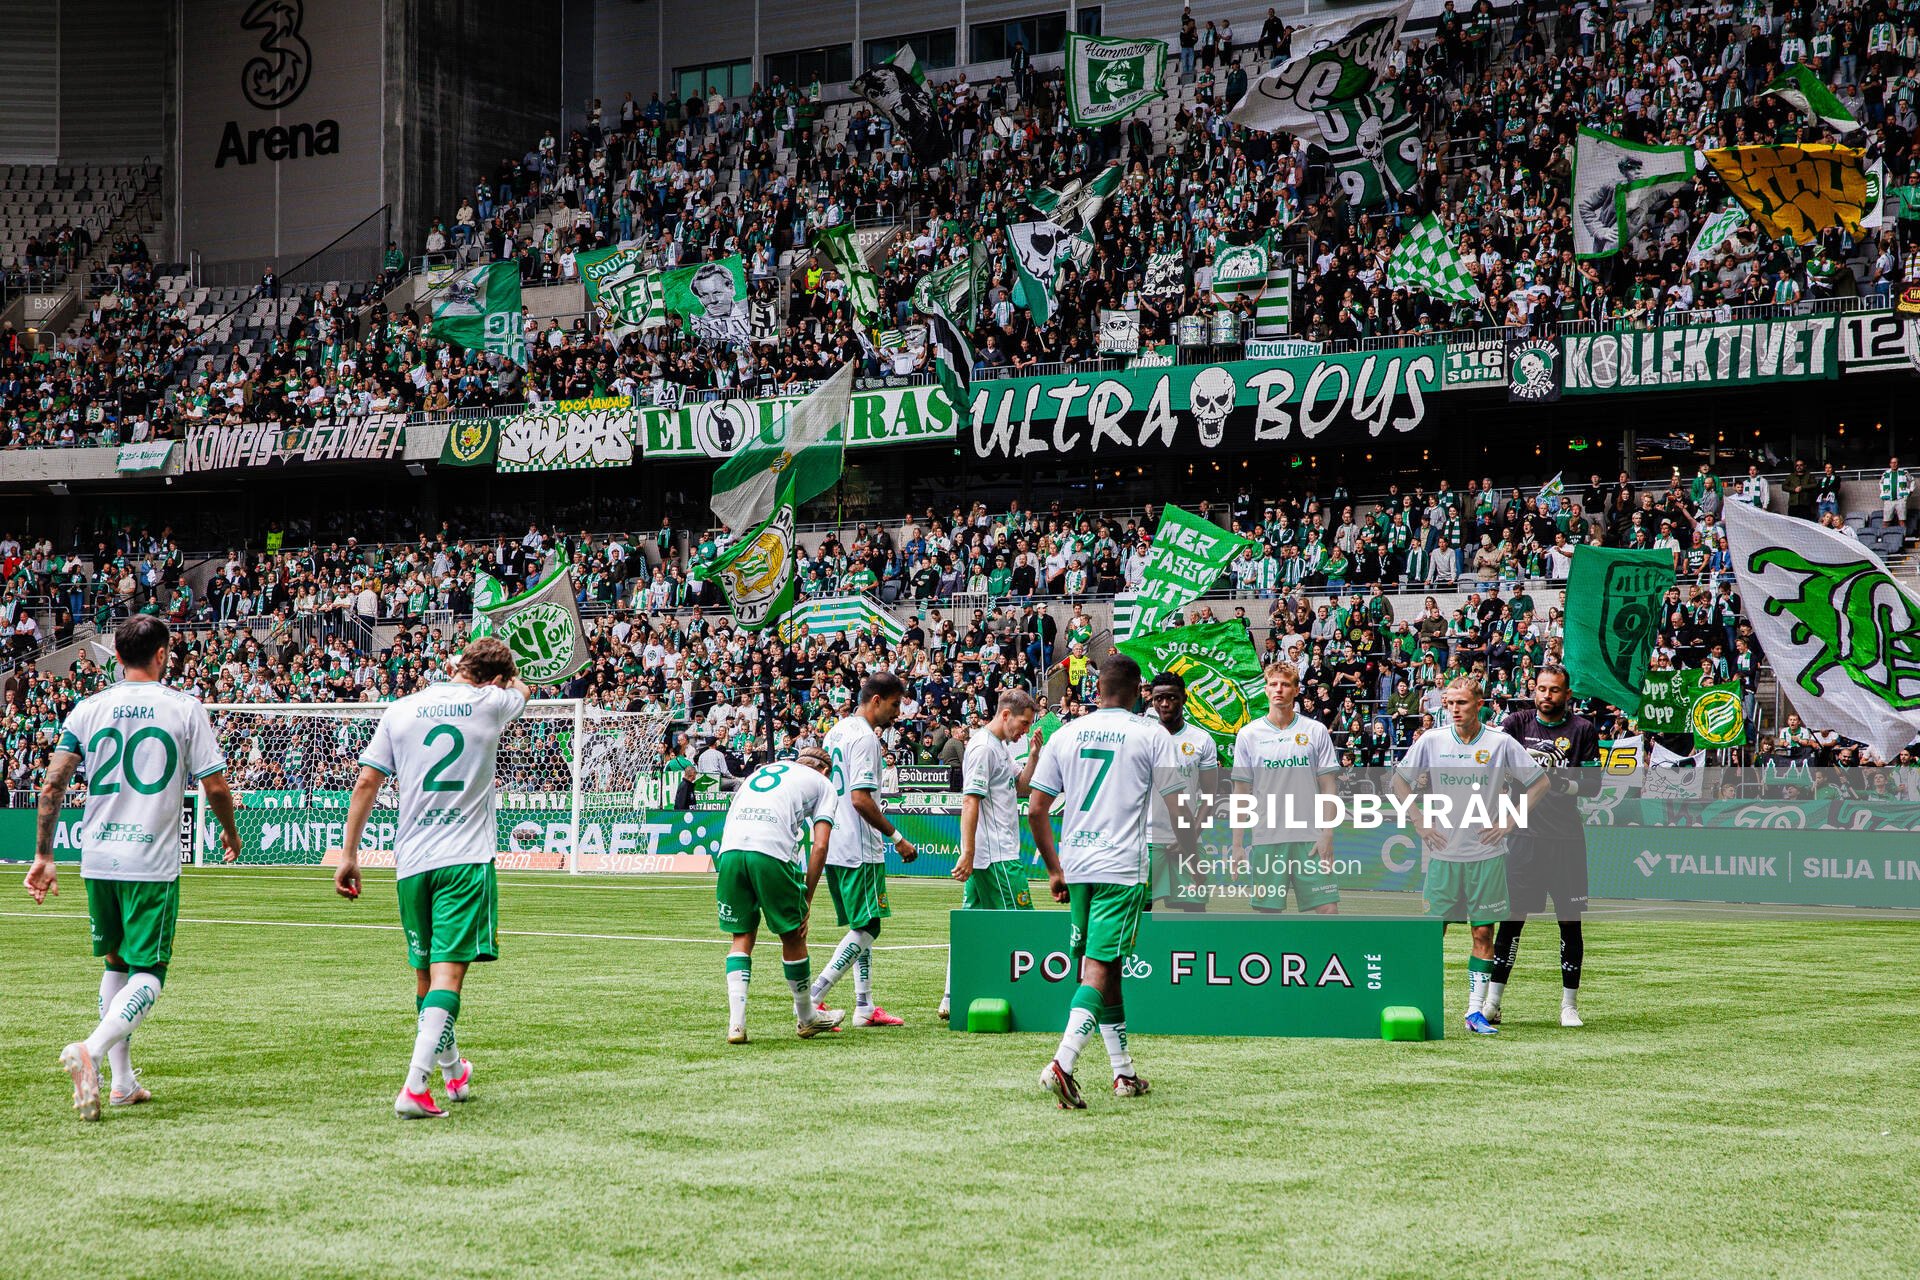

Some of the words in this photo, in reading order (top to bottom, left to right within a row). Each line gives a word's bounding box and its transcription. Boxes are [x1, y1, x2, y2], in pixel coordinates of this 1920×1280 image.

[214, 118, 340, 168] Arena
[1446, 342, 1476, 354] ULTRA
[1477, 340, 1504, 351] BOYS
[1847, 315, 1906, 359] 12
[1447, 350, 1504, 369] 116
[1565, 317, 1836, 389] KOLLEKTIVET
[1447, 366, 1502, 382] SOFIA
[588, 396, 630, 410] VANDALS
[1509, 380, 1556, 399] FOREVER
[969, 373, 1179, 458] ULTRA
[1246, 353, 1437, 441] BOYS
[185, 421, 281, 472] KOMPIS
[303, 413, 407, 462] GÄNGET
[1156, 521, 1220, 559] MER
[112, 704, 155, 720] BESARA
[416, 703, 473, 719] SKOGLUND
[1644, 704, 1674, 724] Opp
[1076, 730, 1126, 745] ABRAHAM
[86, 726, 178, 796] 20
[422, 725, 465, 792] 2
[1264, 755, 1309, 770] Revolut
[749, 764, 790, 793] 8
[899, 768, 949, 782] Söderort
[1080, 749, 1115, 812] 7
[1440, 773, 1489, 786] Revolut
[100, 822, 143, 832] NORDIC
[180, 806, 194, 863] SELECT
[508, 821, 672, 856] CRAFT
[597, 854, 675, 871] SYNSAM
[1665, 854, 1777, 877] TALLINK
[1803, 857, 1874, 881] SILJA
[1885, 859, 1920, 881] LIN
[1010, 950, 1087, 983] PO
[1122, 954, 1153, 979] &
[1171, 950, 1356, 989] FLORA
[1368, 953, 1383, 990] CAFÉ
